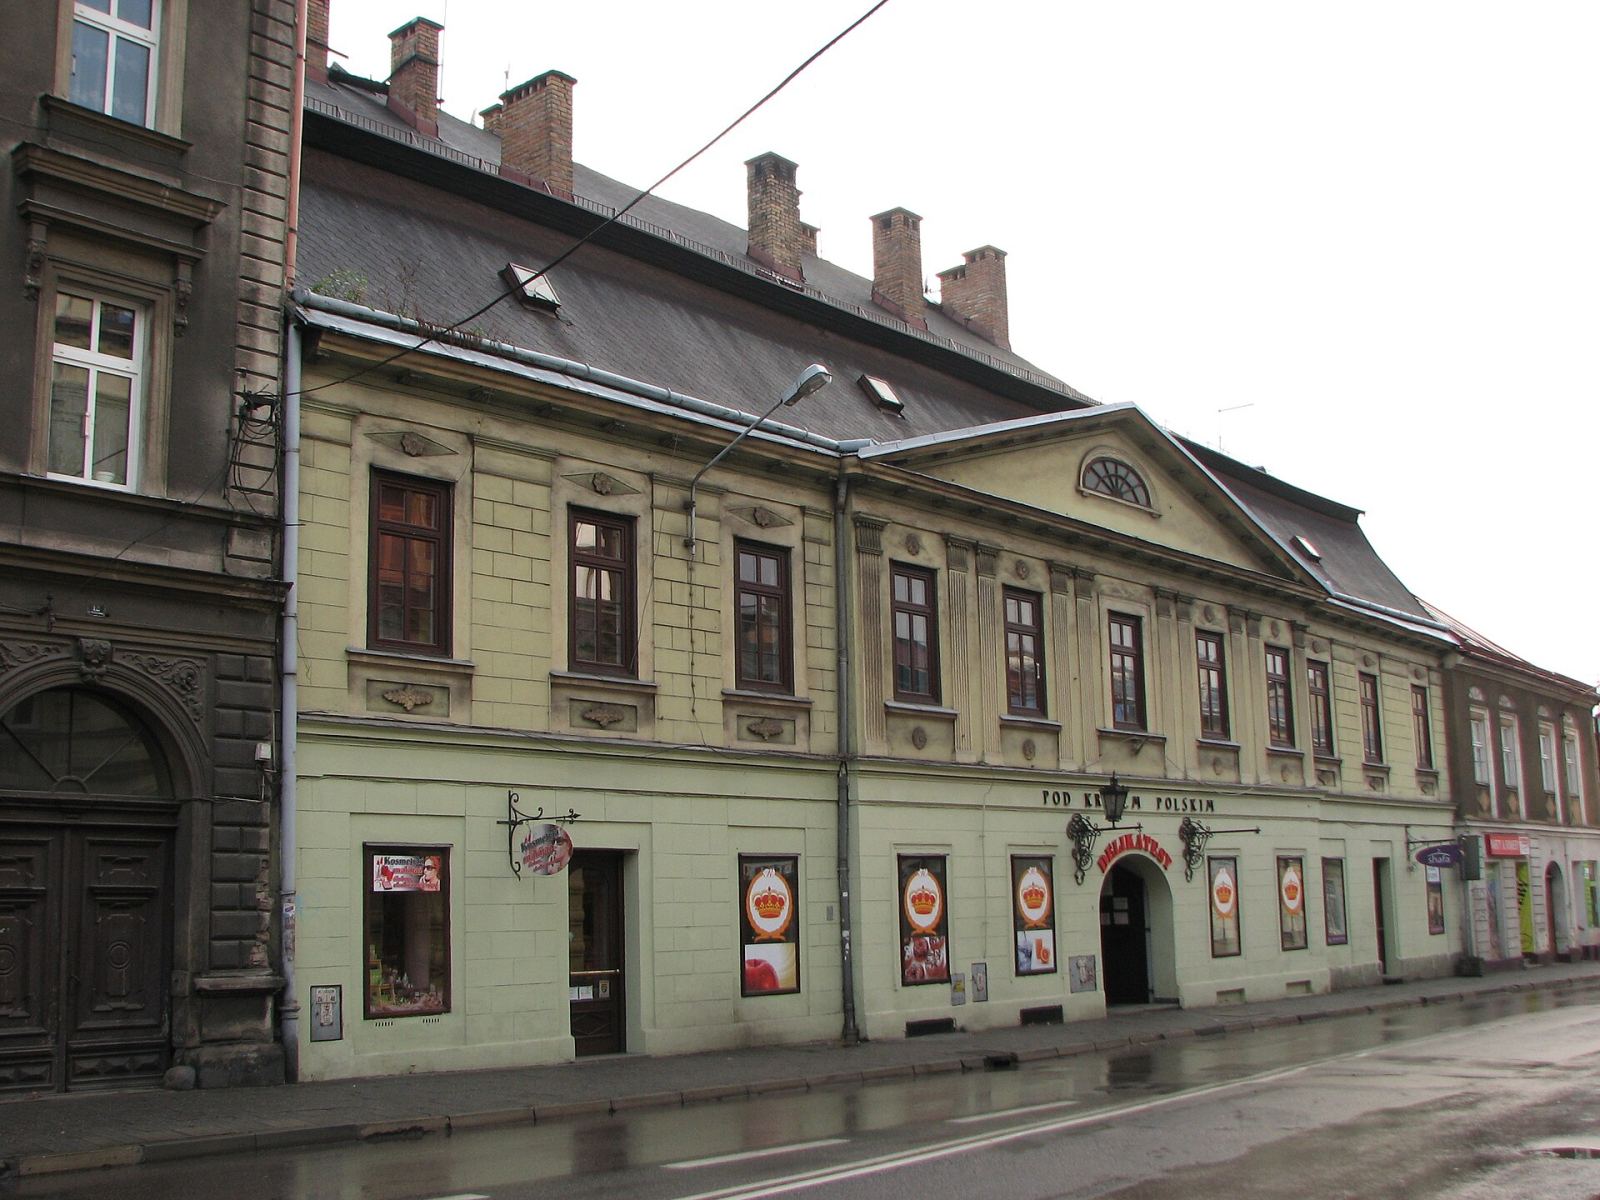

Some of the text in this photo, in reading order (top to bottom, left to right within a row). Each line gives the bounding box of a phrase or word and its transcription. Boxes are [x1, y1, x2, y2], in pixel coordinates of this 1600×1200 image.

[1042, 790, 1215, 812] POD KRM POLSKIM
[1097, 833, 1173, 874] DELIKATESY
